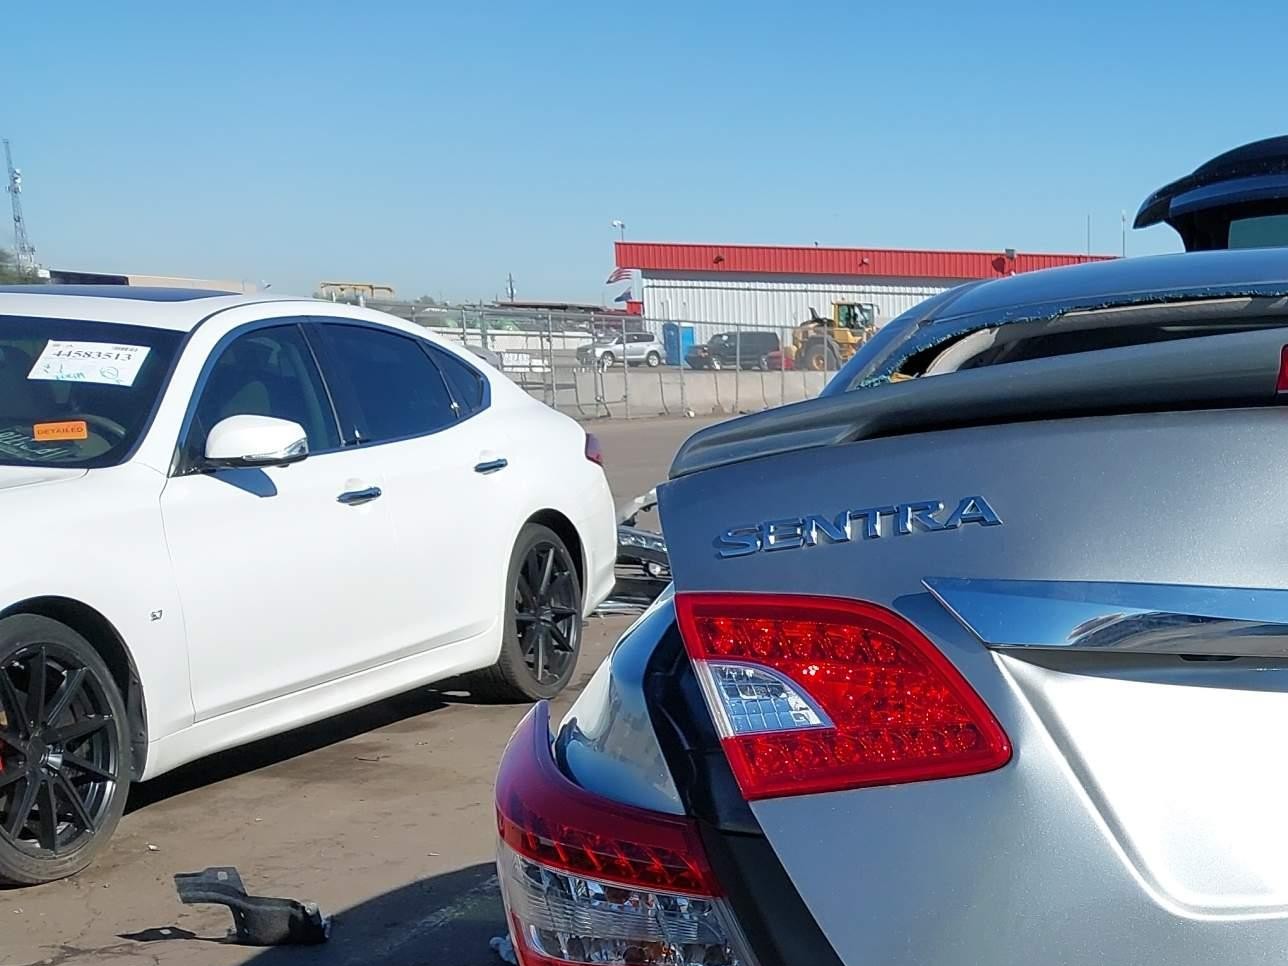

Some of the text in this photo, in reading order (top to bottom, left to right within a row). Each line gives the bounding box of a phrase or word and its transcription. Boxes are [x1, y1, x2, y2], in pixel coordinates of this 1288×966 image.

[51, 350, 133, 361] 44583513
[36, 426, 84, 435] DETAILED
[714, 495, 1003, 559] SENTRA
